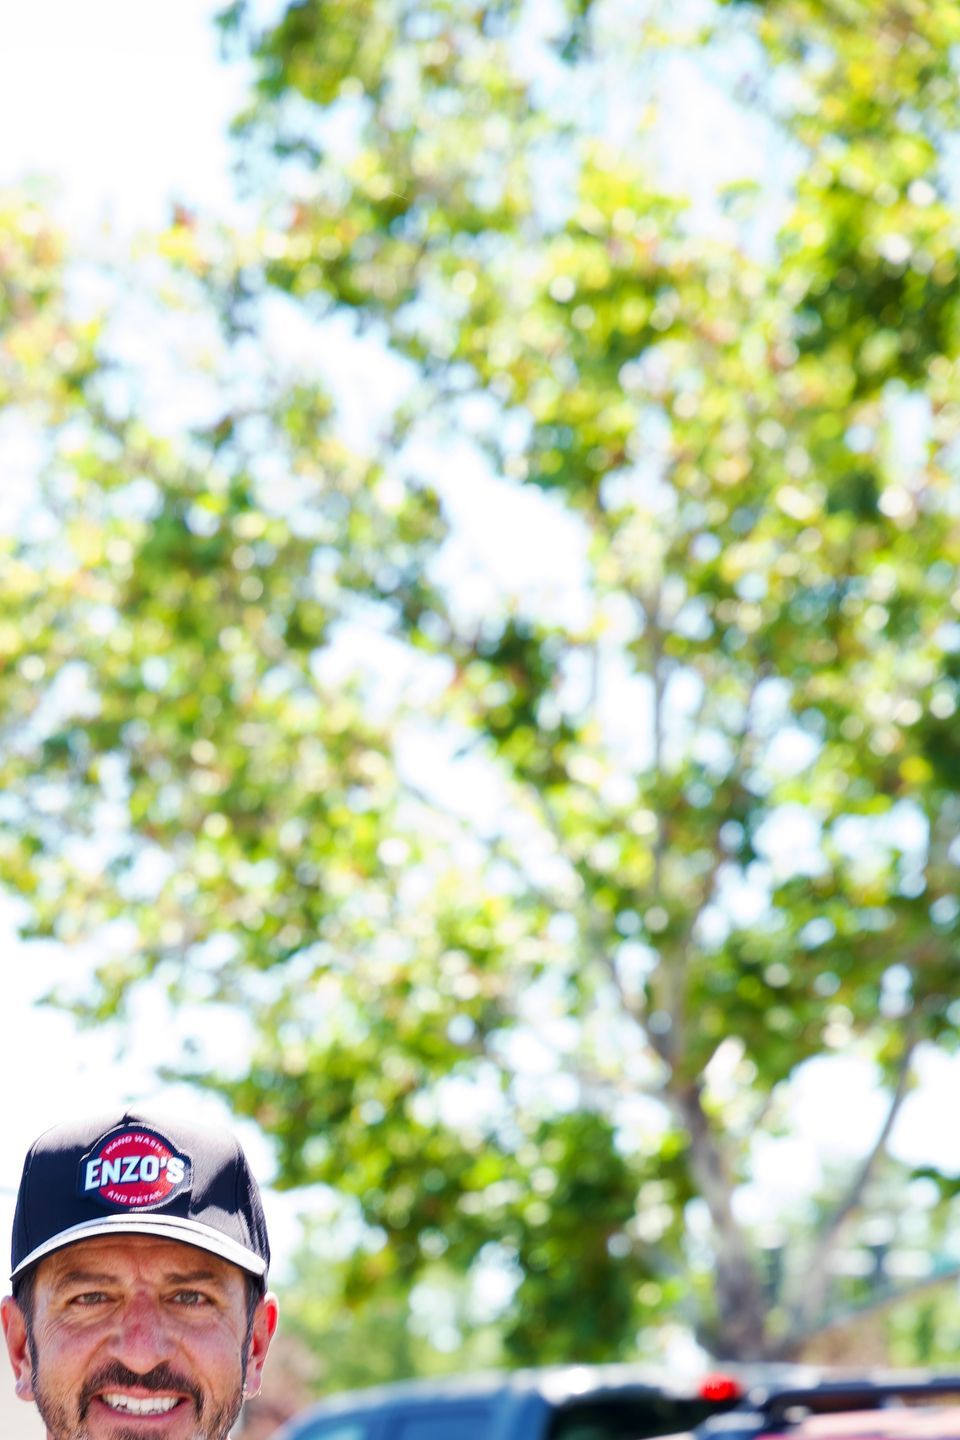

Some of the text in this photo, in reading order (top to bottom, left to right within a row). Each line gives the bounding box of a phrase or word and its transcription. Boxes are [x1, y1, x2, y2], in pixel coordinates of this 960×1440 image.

[105, 1135, 163, 1154] HAND WASH
[85, 1155, 185, 1190] ENZO'S
[107, 1190, 128, 1202] AND
